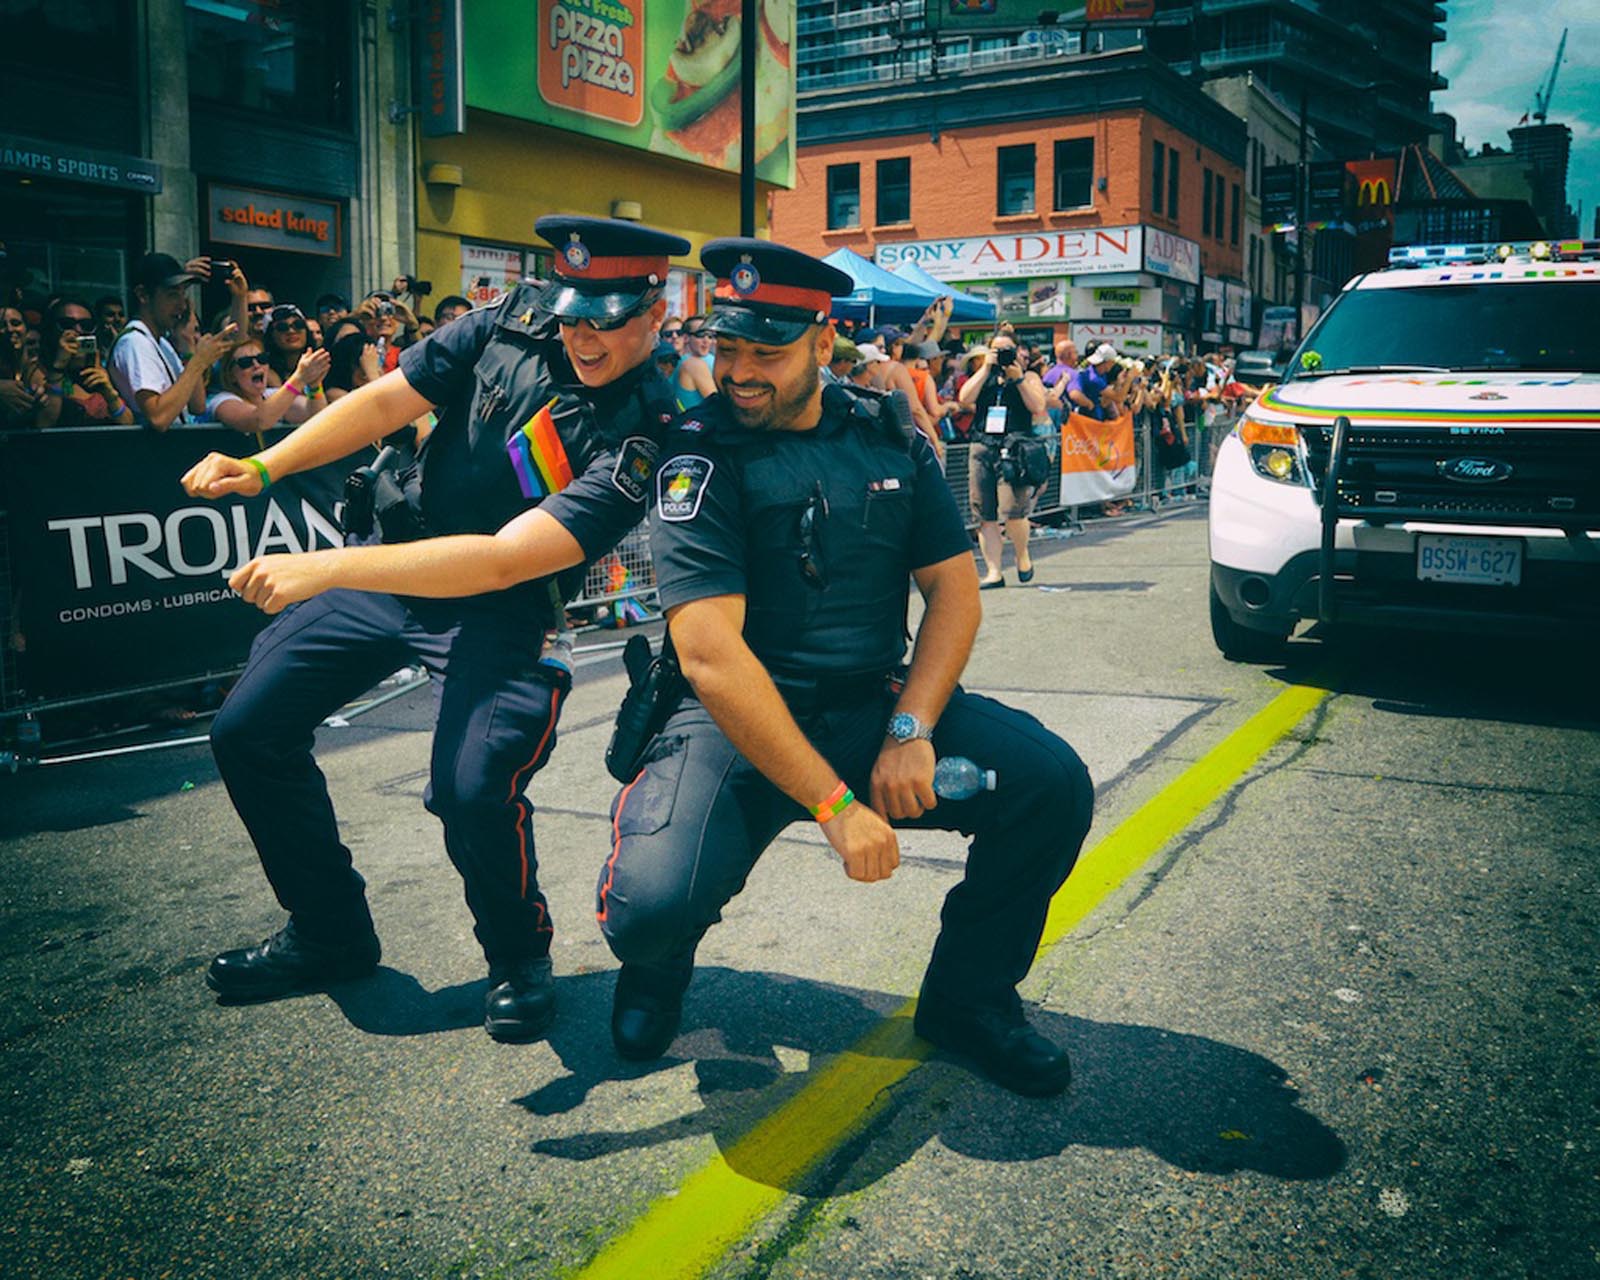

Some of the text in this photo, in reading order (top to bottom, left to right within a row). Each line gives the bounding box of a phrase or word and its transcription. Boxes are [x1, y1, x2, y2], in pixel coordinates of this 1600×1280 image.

[0, 149, 119, 181] AMPS SPORTS
[223, 203, 329, 241] salad king
[880, 229, 1133, 264] SONY ADEN
[1151, 232, 1193, 266] ADEN
[1099, 290, 1135, 302] Nikon
[1077, 325, 1160, 337] ADEN
[1453, 459, 1496, 478] Ford
[663, 501, 693, 513] POLICE
[48, 497, 347, 590] TROJAN
[59, 598, 152, 623] CONDOMS
